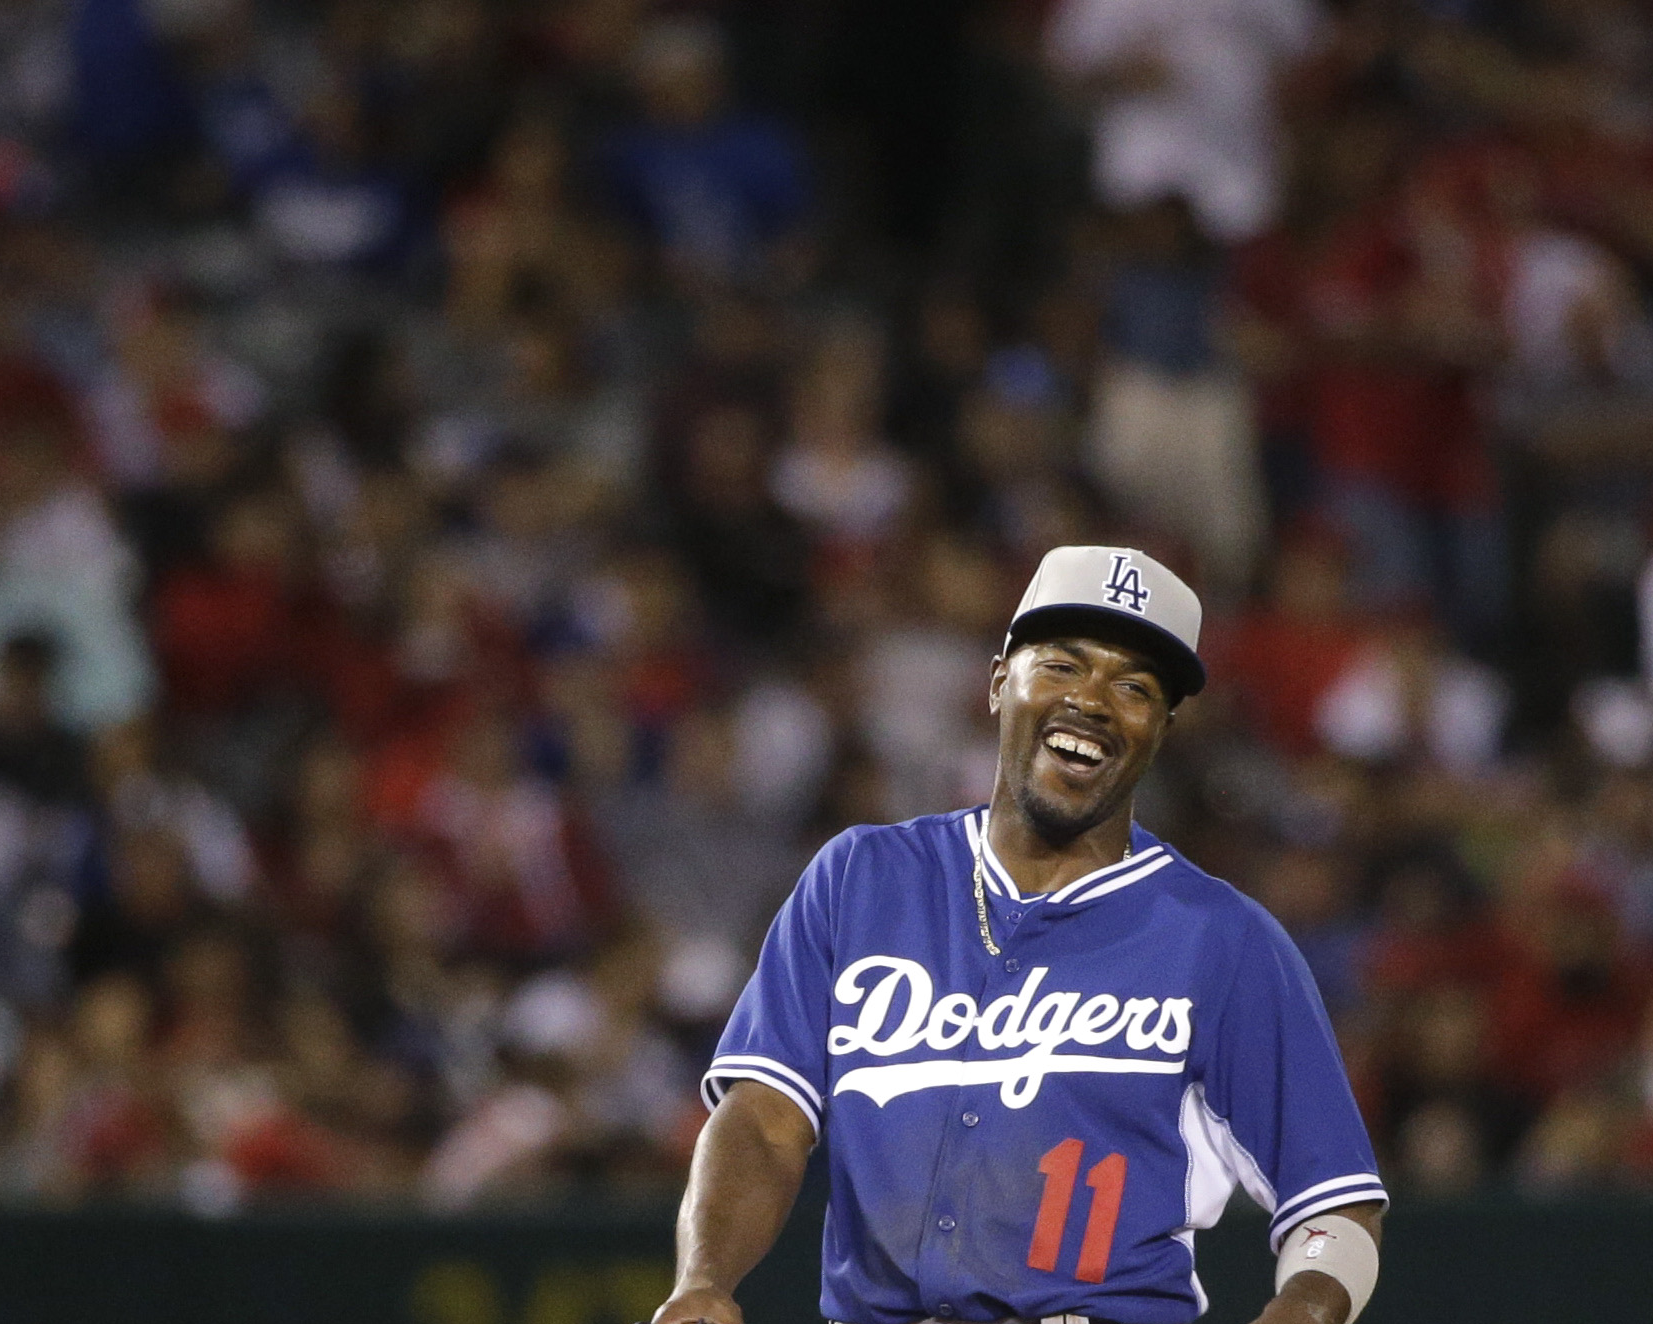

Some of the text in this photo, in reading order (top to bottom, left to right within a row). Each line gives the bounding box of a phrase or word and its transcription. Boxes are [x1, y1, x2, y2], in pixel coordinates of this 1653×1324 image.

[1102, 553, 1151, 615] LA
[827, 955, 1193, 1109] Dodgers
[1026, 1137, 1128, 1284] 11
